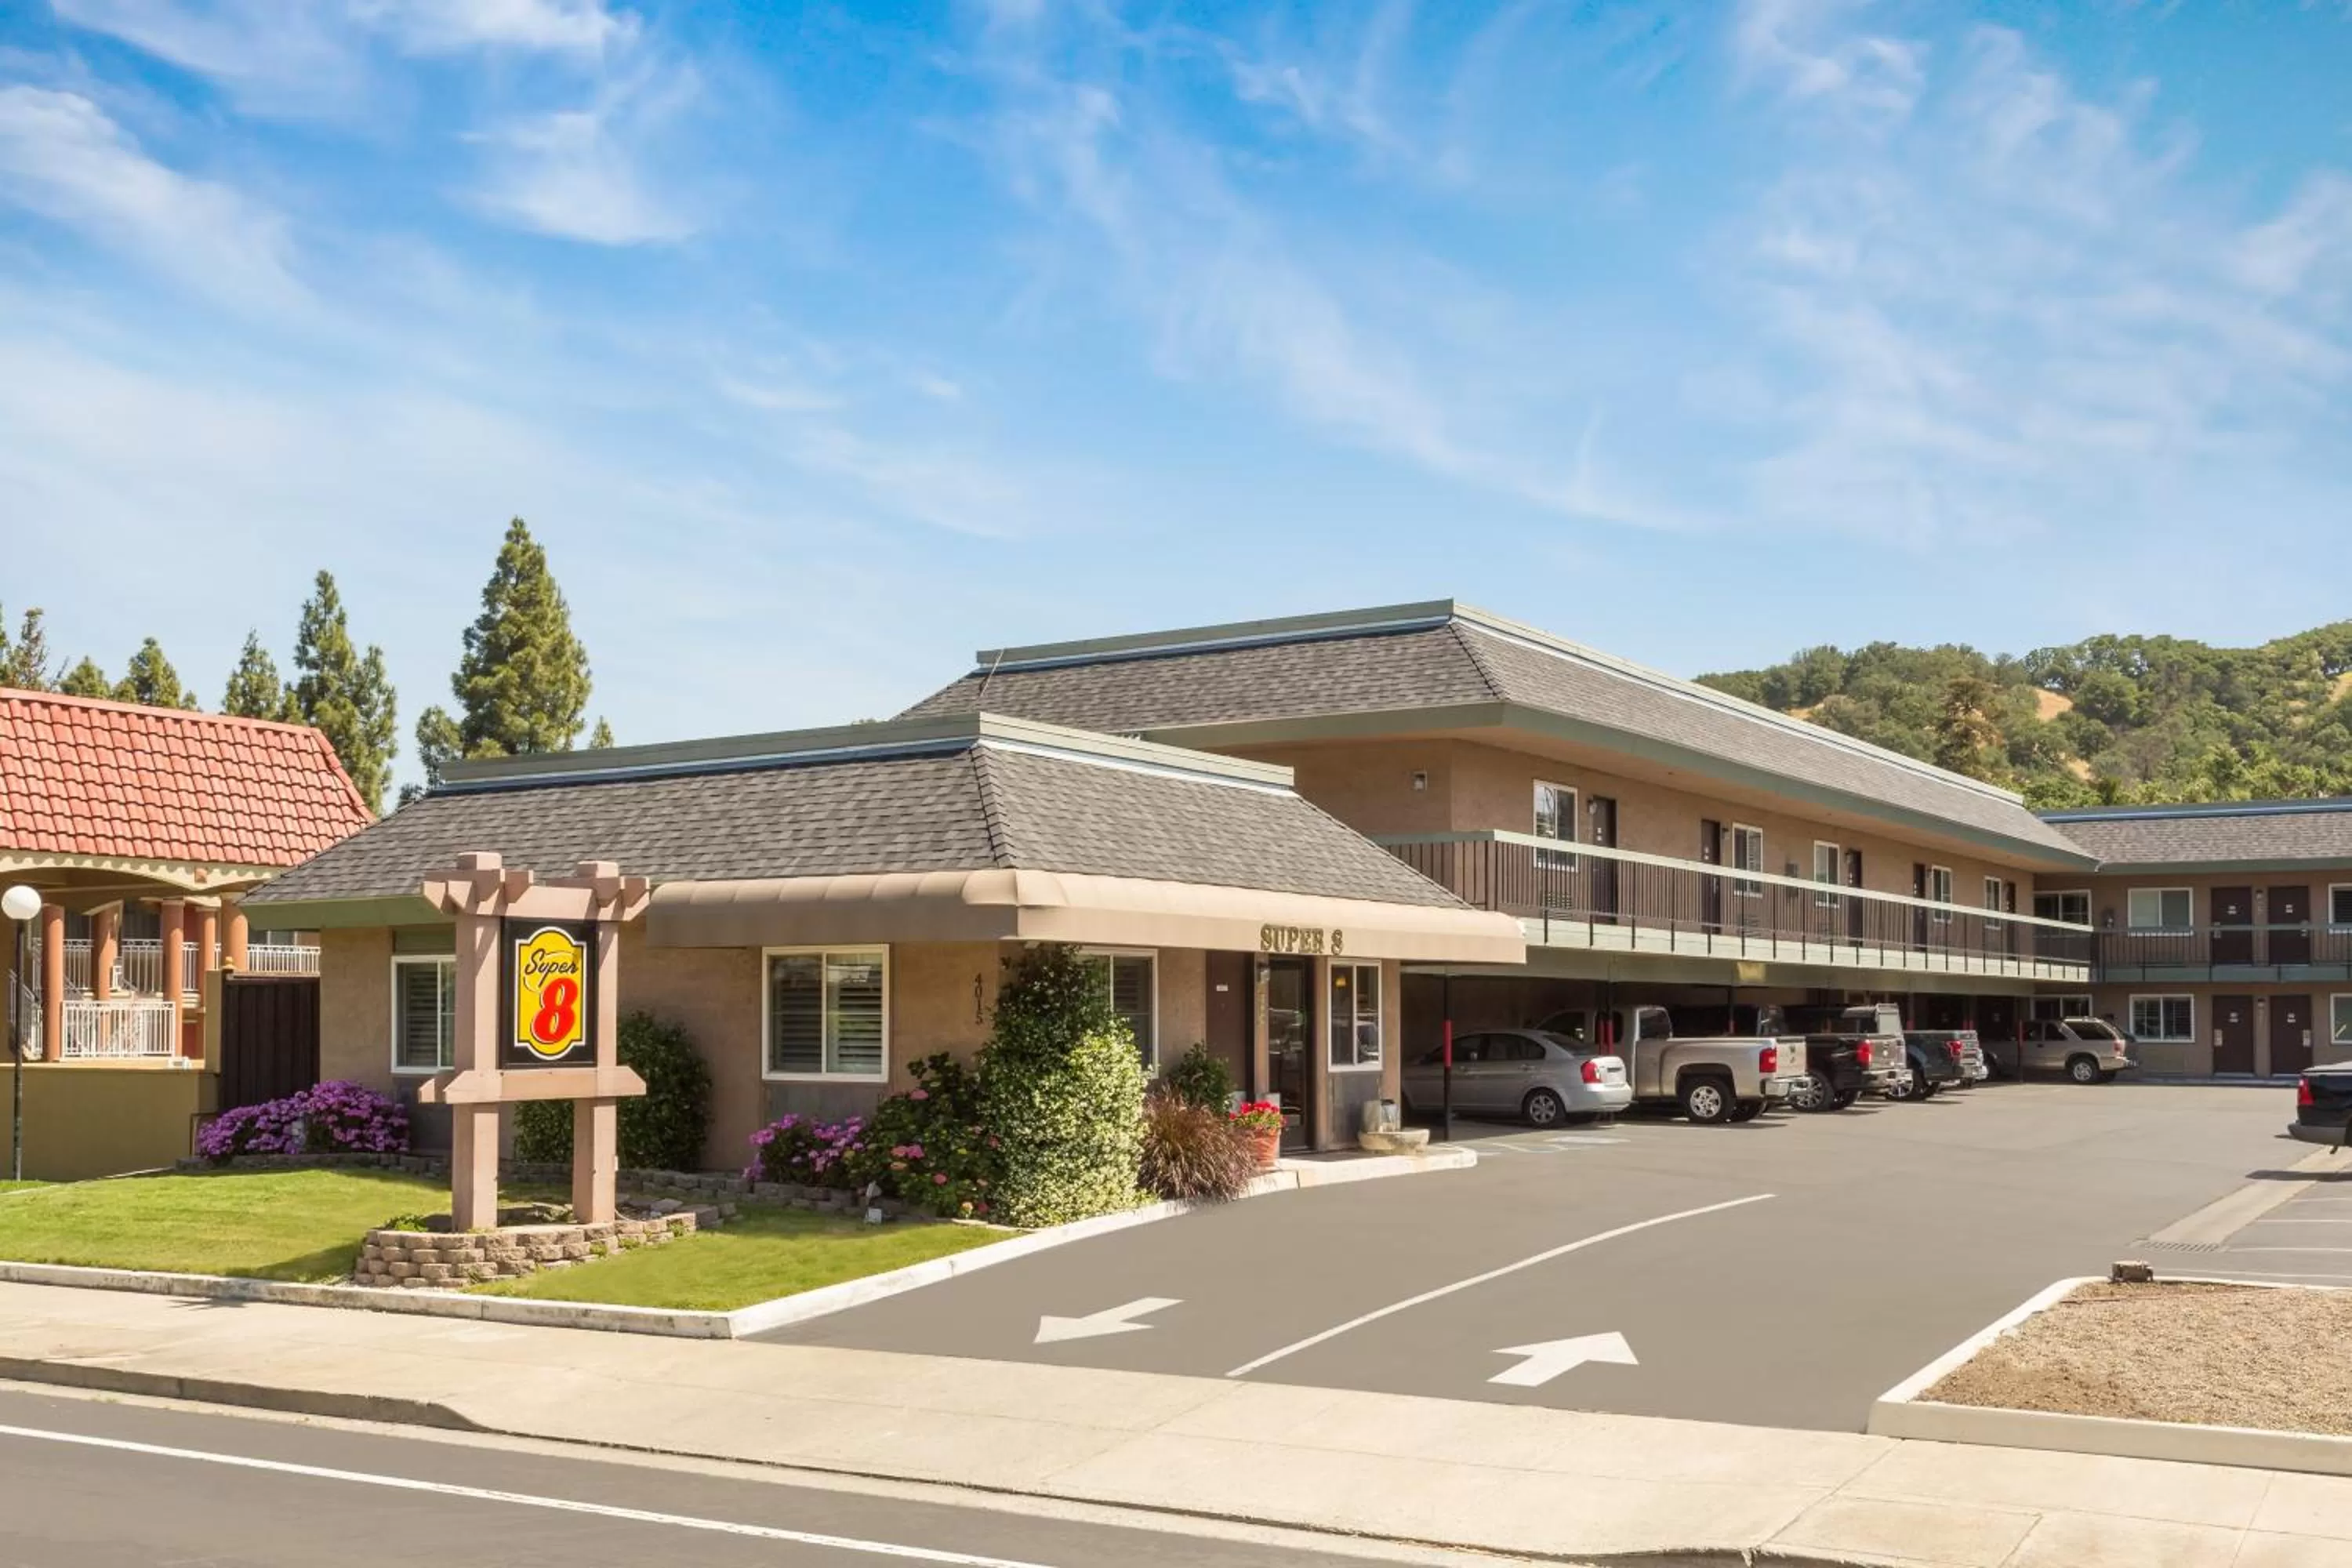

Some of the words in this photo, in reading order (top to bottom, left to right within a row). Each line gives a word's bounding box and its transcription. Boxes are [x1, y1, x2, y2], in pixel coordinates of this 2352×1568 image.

[1260, 924, 1324, 954] SUPER
[1331, 929, 1343, 956] 8
[524, 948, 578, 988] Super
[531, 978, 578, 1044] 8
[975, 972, 983, 1025] 4015
